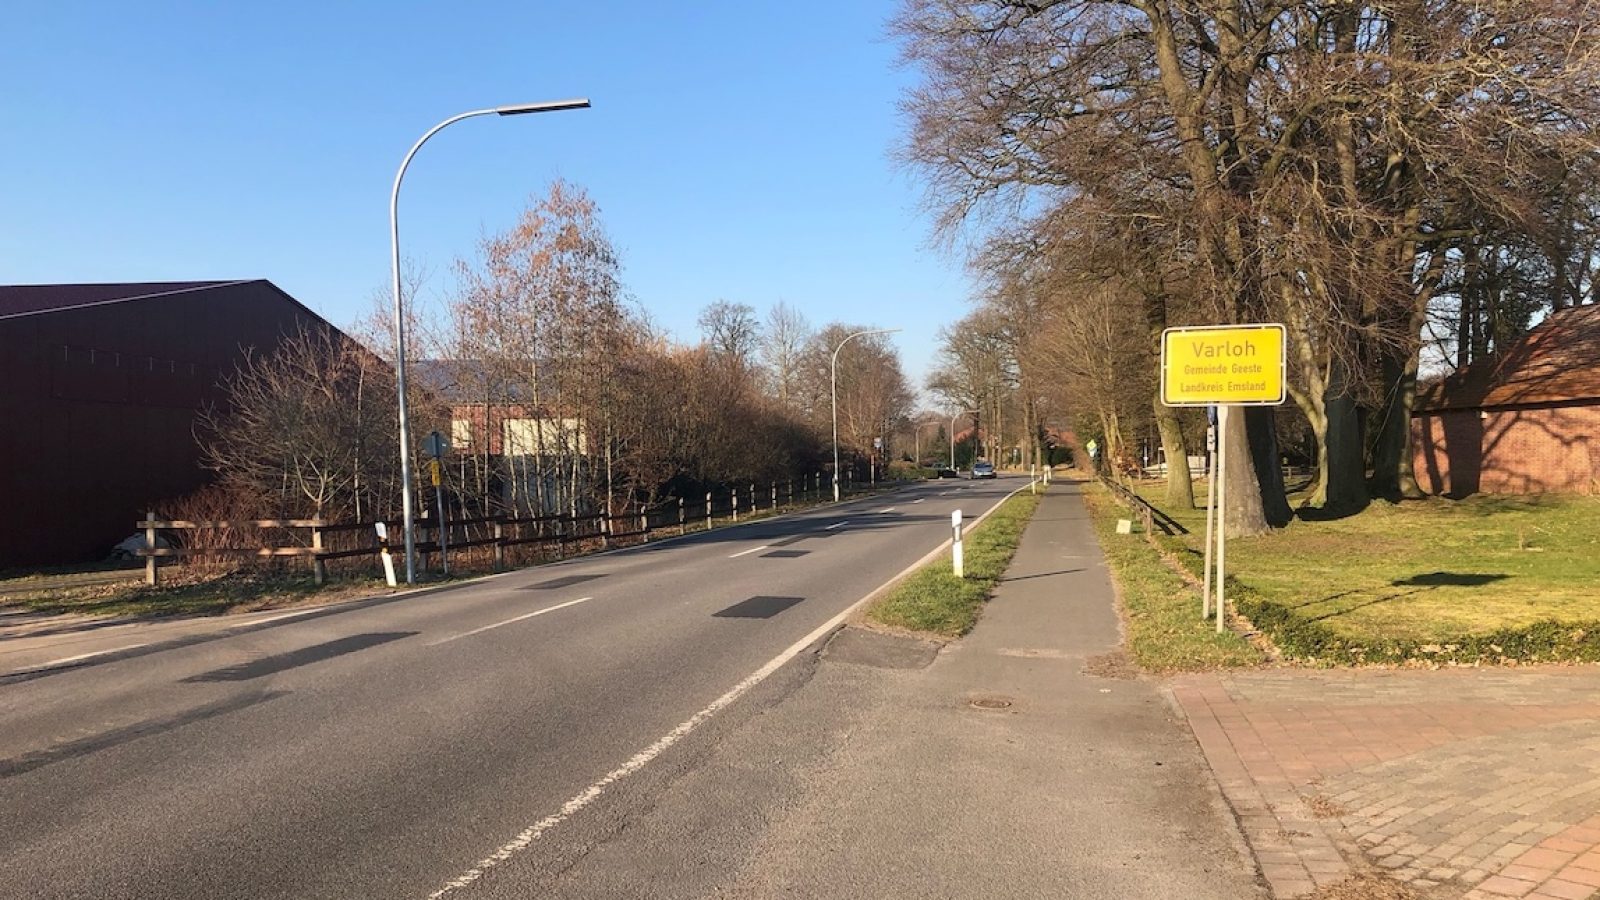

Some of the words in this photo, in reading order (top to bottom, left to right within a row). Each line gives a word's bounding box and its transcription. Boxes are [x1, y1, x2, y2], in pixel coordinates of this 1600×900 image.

[1192, 340, 1255, 357] Varloh
[1184, 364, 1228, 375] Gemeinde
[1231, 363, 1262, 373] Geeste
[1180, 382, 1224, 393] Landkreis
[1228, 381, 1266, 391] Emsland
